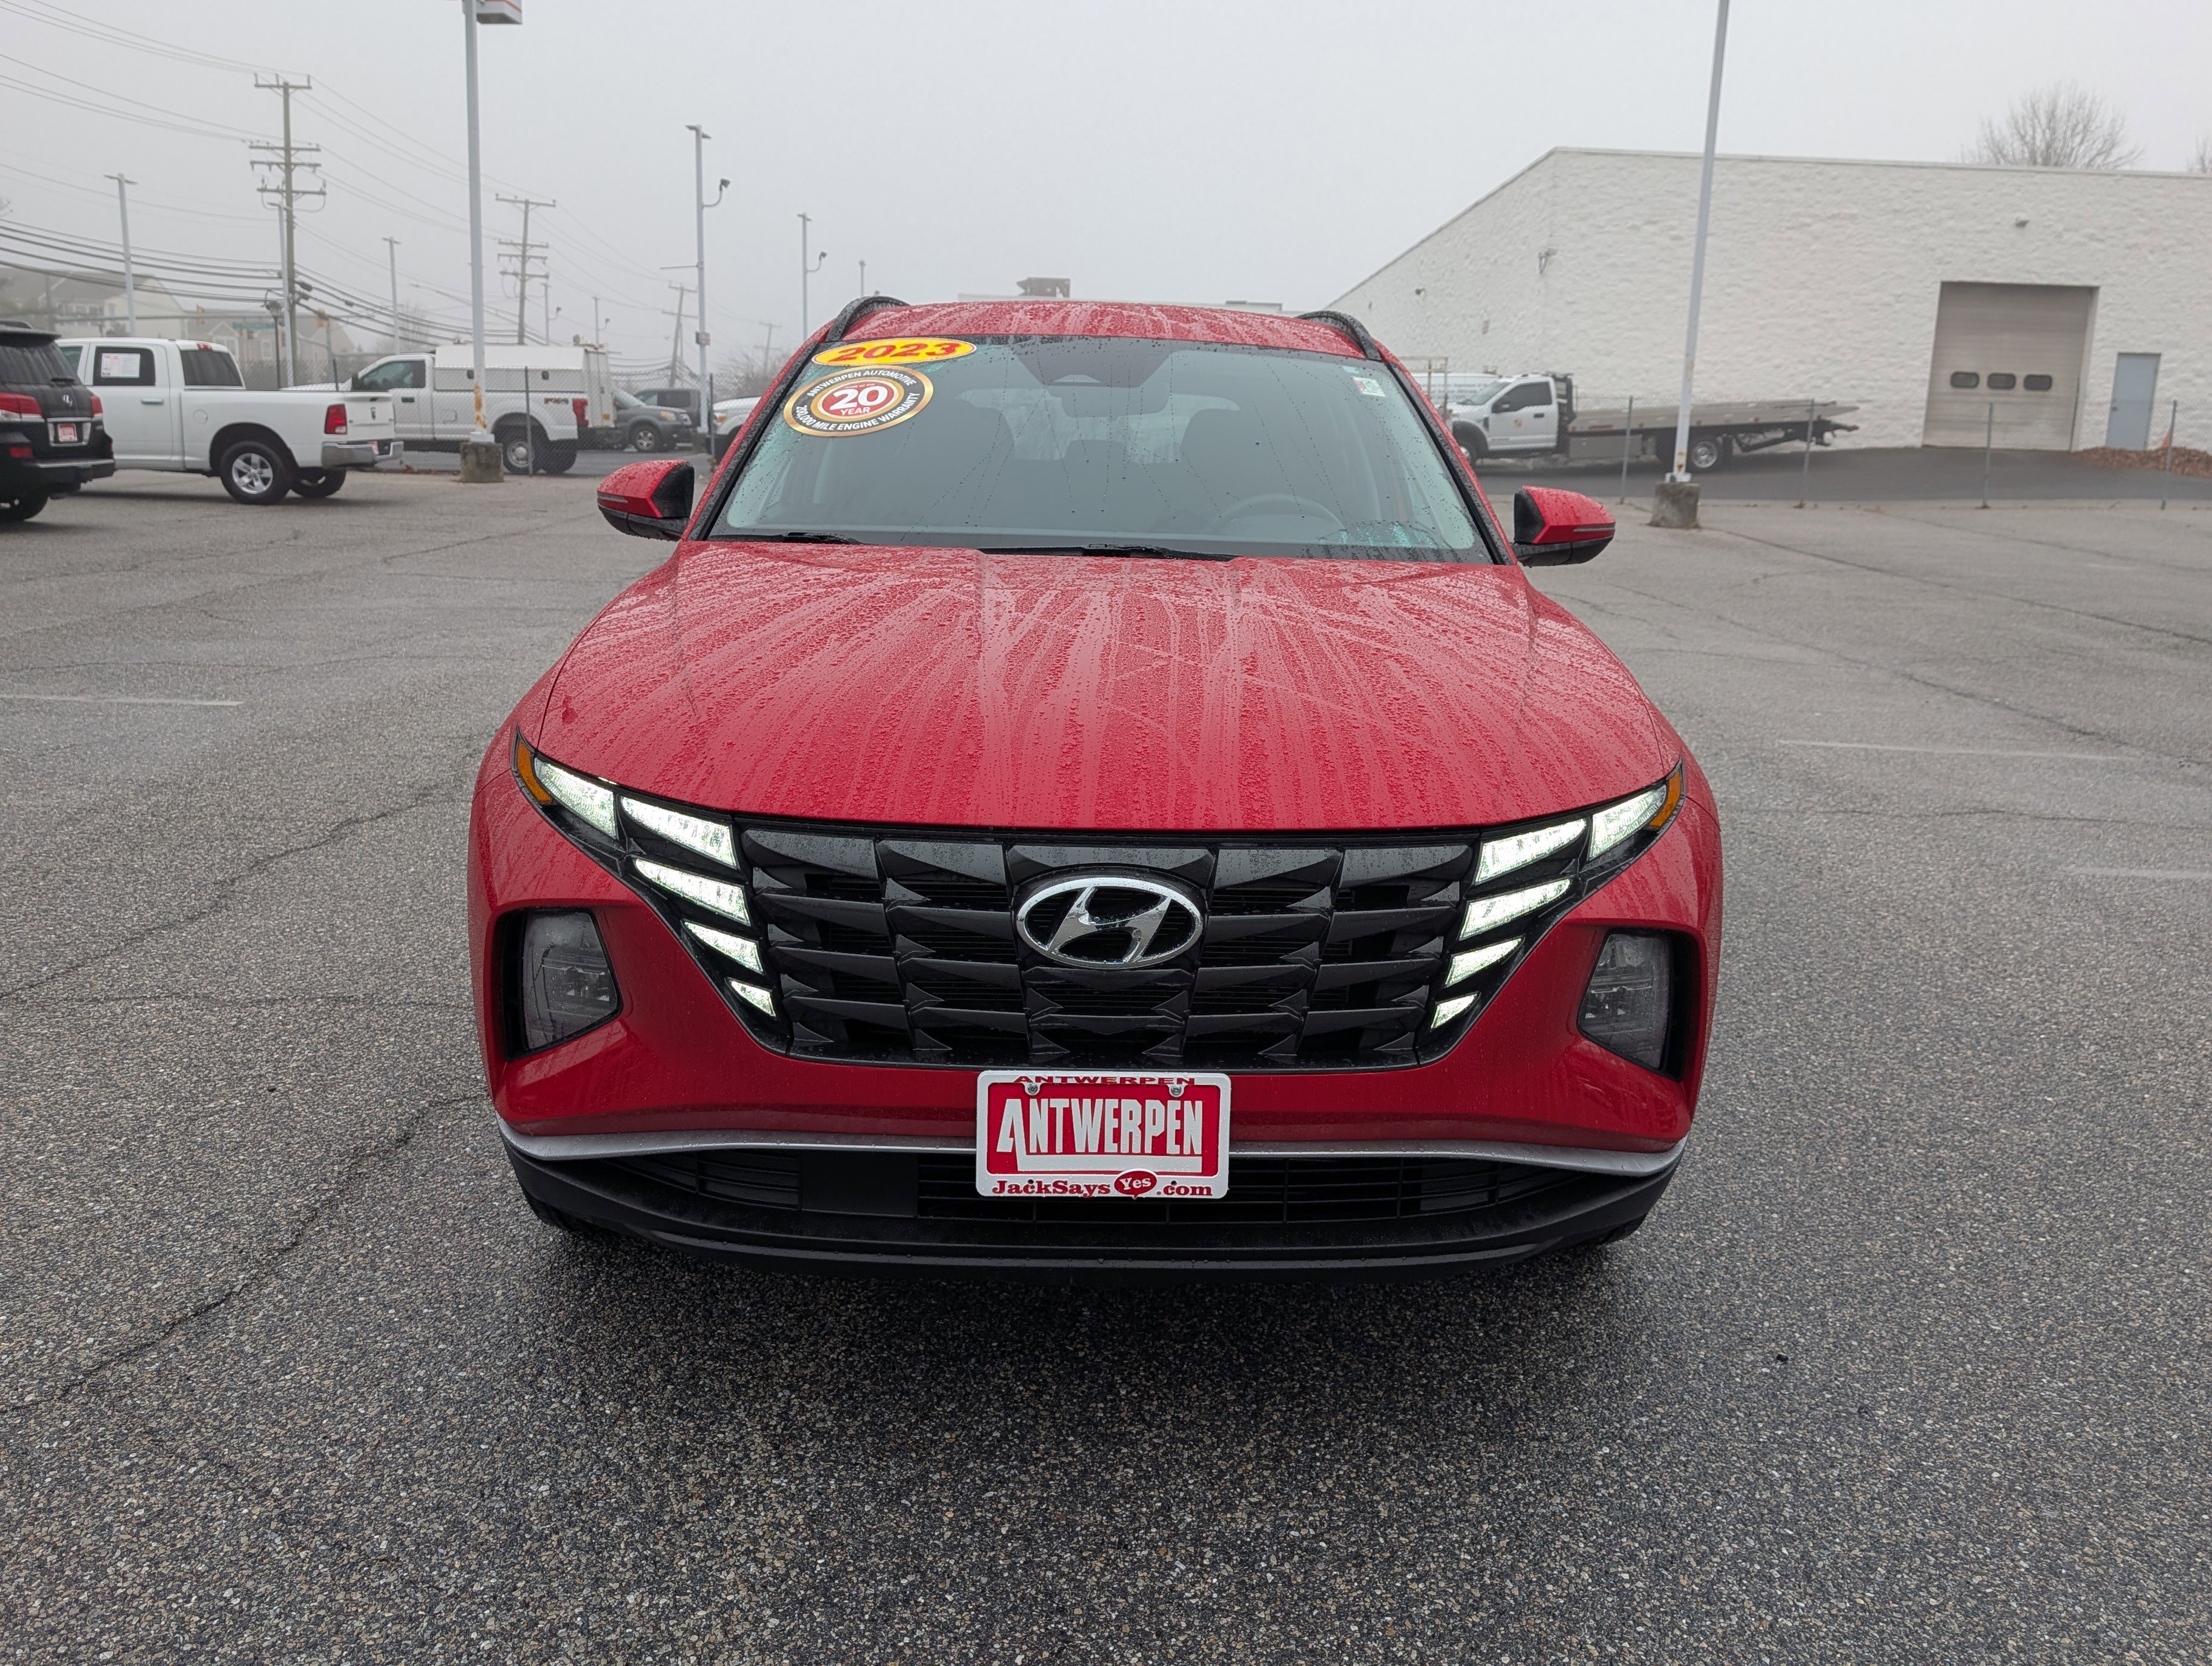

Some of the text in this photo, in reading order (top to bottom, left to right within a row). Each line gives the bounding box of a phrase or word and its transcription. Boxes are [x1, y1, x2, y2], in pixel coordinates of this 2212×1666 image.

[827, 343, 961, 362] 2023
[807, 370, 917, 397] ANTWERPEN AUTOMOTIVE
[829, 386, 888, 410] 20
[837, 419, 879, 431] ENGINE
[877, 392, 921, 421] WARRANTY
[840, 407, 871, 416] YEAR
[1013, 1075, 1195, 1085] ANTWERPEN
[996, 1099, 1203, 1172] ANTWERPEN
[1119, 1177, 1152, 1190] Yes
